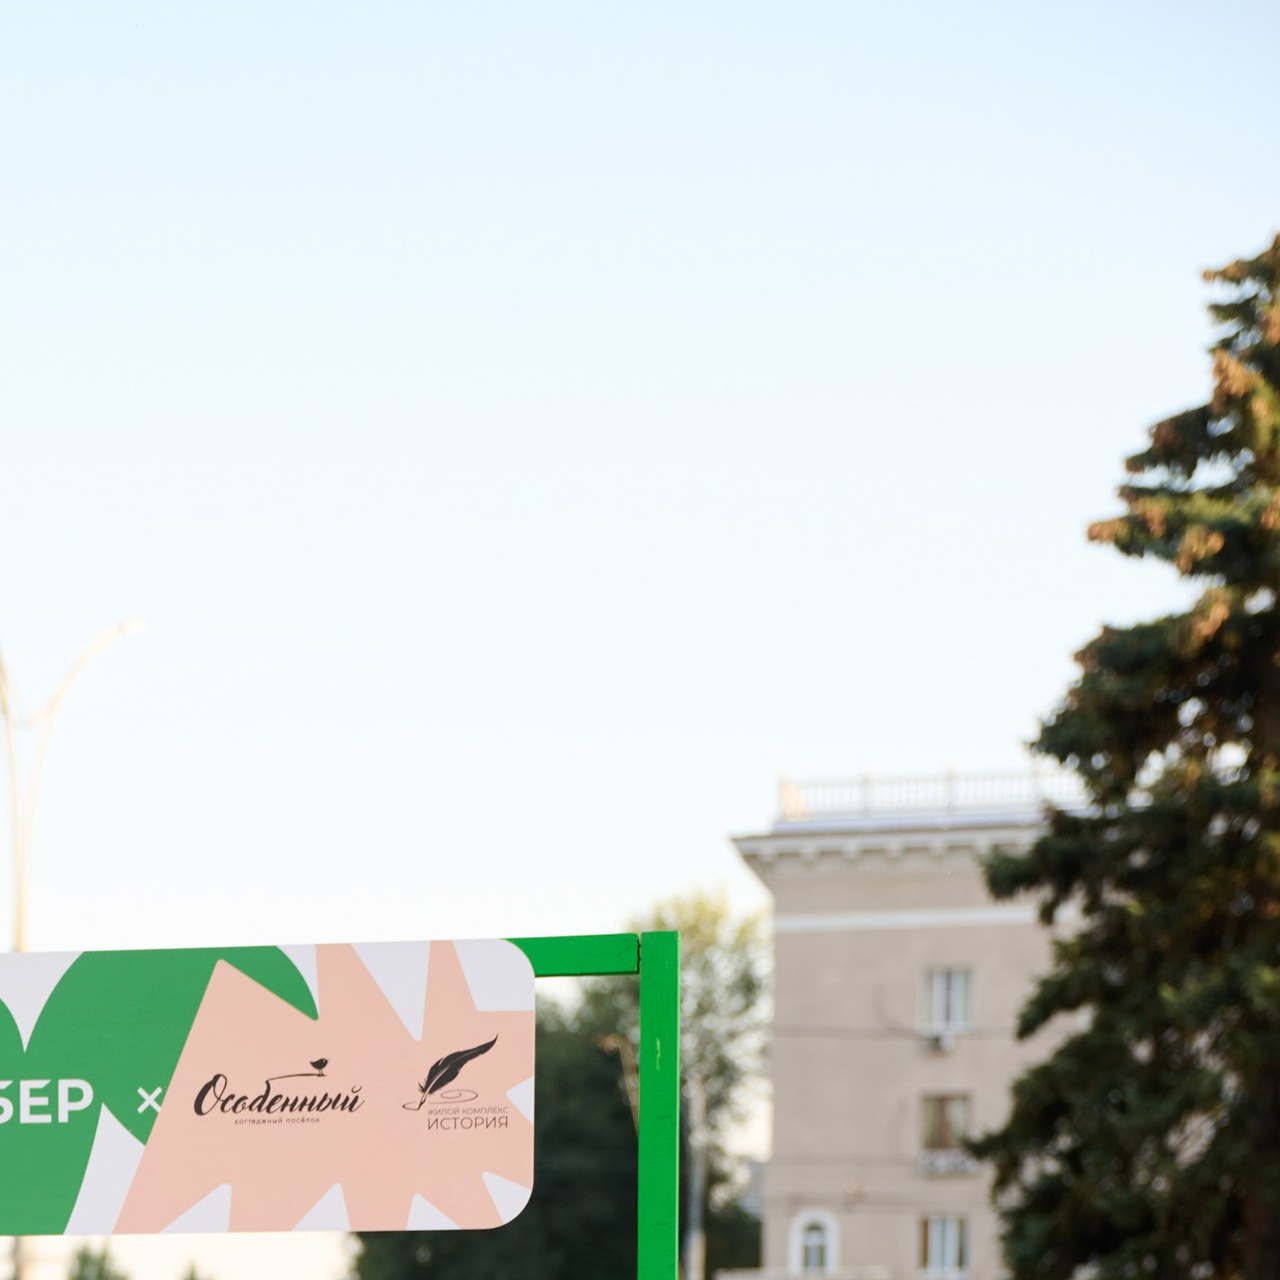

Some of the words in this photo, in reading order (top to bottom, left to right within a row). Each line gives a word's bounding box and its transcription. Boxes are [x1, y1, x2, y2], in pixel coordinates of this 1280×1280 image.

[193, 1073, 366, 1117] Особенный
[427, 1106, 460, 1116] ЖИЛОЙ
[461, 1106, 509, 1115] КОМПЛЕКС
[234, 1116, 283, 1126] коттеджный
[427, 1115, 509, 1131] ИСТОРИЯ
